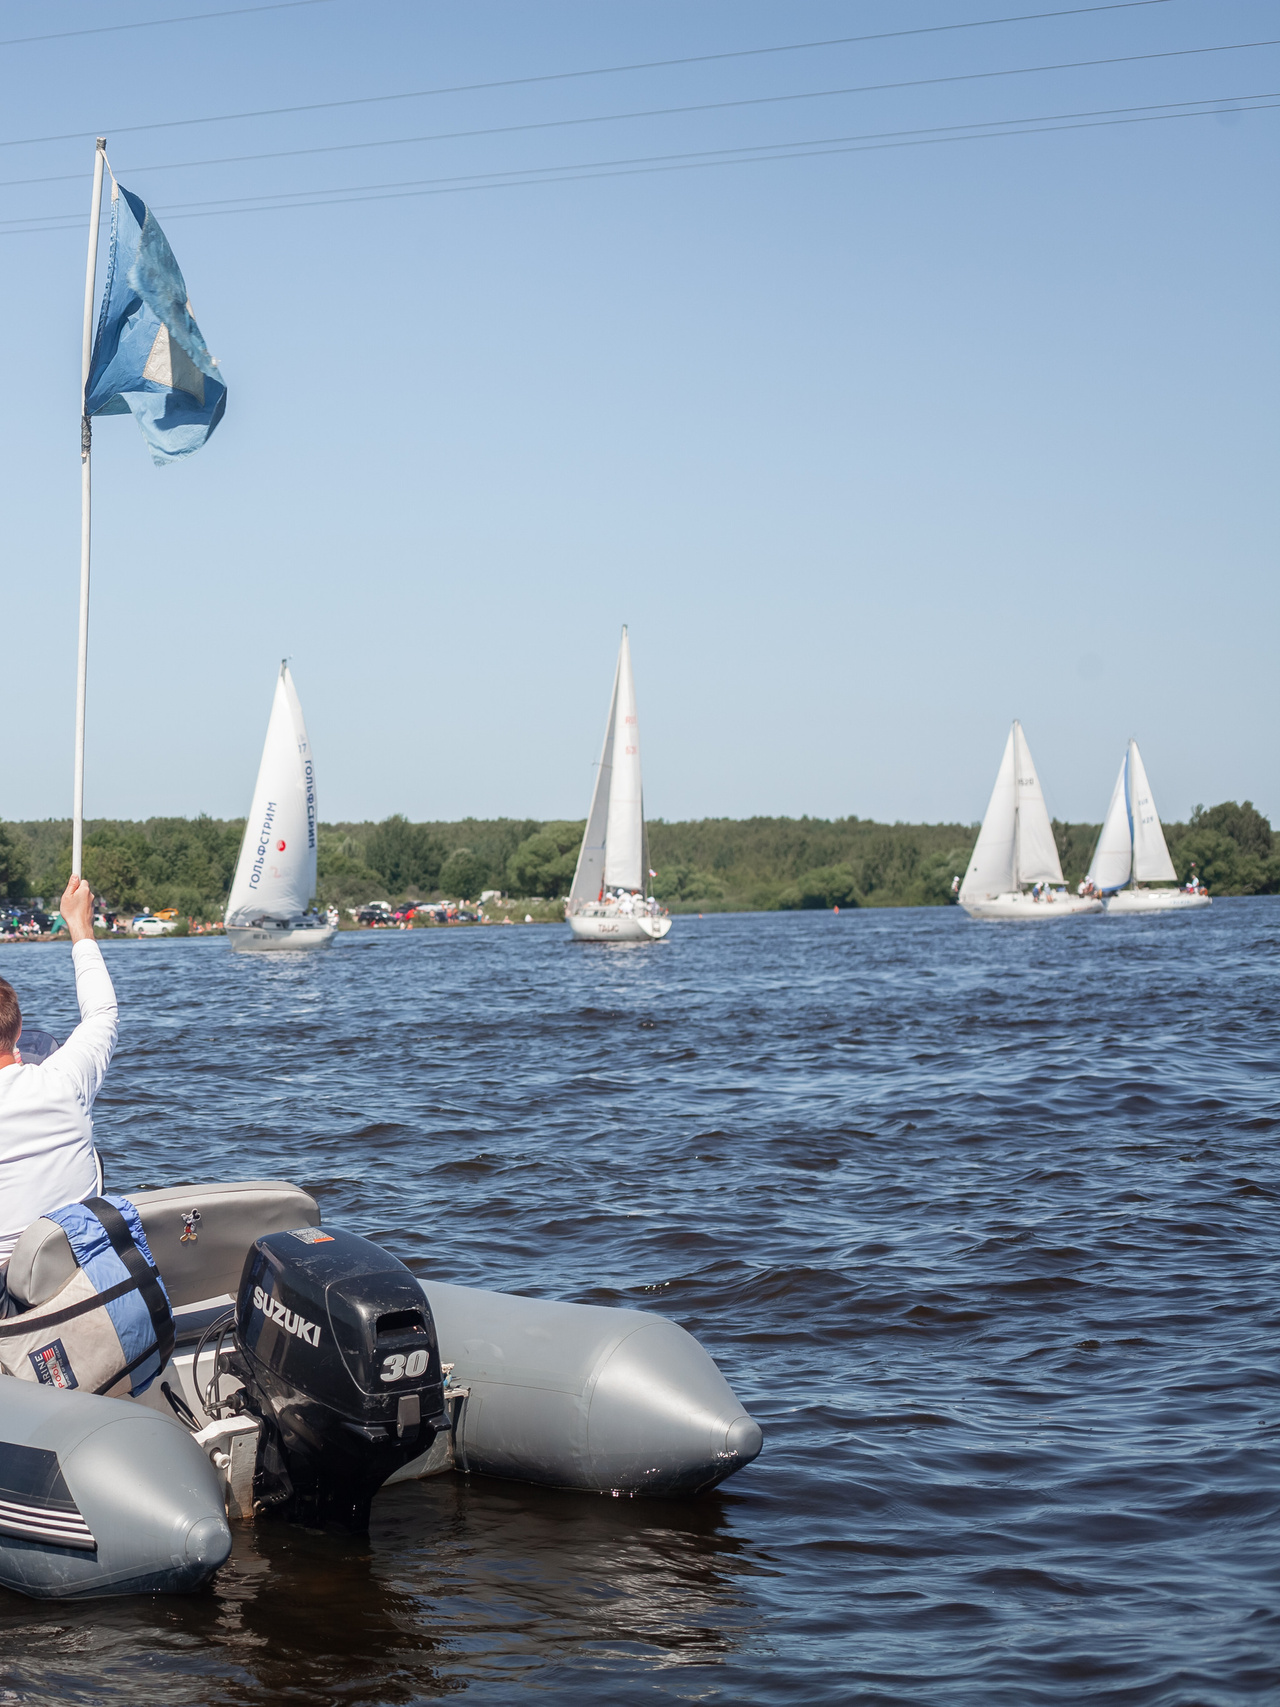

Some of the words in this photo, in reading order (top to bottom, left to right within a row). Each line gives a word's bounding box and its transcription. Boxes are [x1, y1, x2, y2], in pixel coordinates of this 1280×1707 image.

[249, 801, 277, 890] ГОЛЬФСТРИМ
[253, 1286, 322, 1348] SUZUKI
[34, 1353, 53, 1385] ARINE
[51, 1363, 65, 1388] POOL
[379, 1350, 430, 1382] 30
